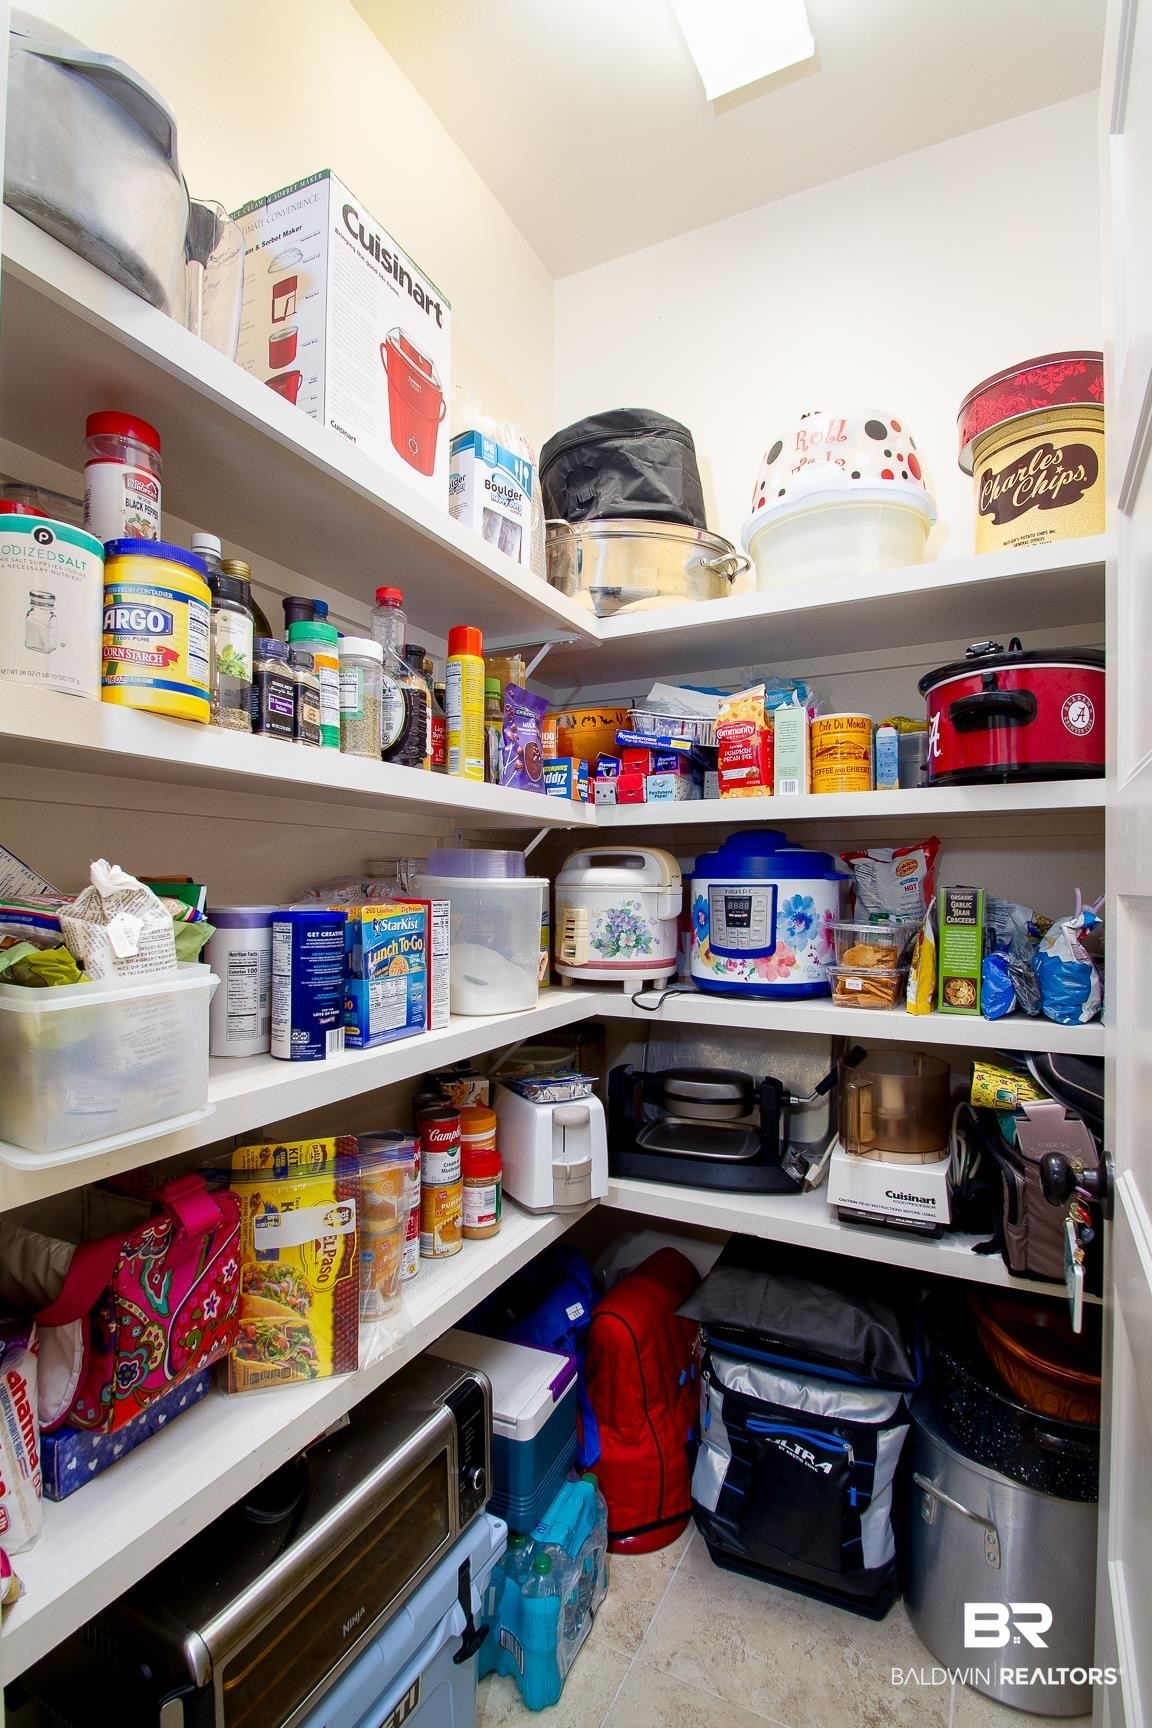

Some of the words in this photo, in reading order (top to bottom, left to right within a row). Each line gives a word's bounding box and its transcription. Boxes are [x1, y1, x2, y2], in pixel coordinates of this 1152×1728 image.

[274, 185, 297, 200] SORBET
[300, 174, 323, 186] MAKER
[242, 220, 266, 234] TIMATE
[266, 193, 320, 224] CONVENIENCE
[262, 235, 281, 248] Sorbet
[283, 225, 302, 237] Maker
[342, 204, 442, 328] Cuisinart
[330, 420, 357, 444] Cuisinart
[484, 480, 522, 501] Boulder
[980, 448, 1063, 512] Charles
[1012, 465, 1086, 506] Chips
[126, 498, 143, 511] BLACK
[1, 545, 56, 560] ODIZED
[58, 554, 86, 571] SALT
[136, 588, 173, 599] CONTAINER
[103, 609, 164, 632] ARGO
[104, 646, 125, 657] CORN
[125, 648, 163, 663] STARCH
[1064, 696, 1093, 713] ALABAMA
[1072, 706, 1086, 722] A
[717, 725, 754, 738] Community
[834, 719, 844, 729] Du
[847, 718, 867, 729] Monde
[814, 767, 833, 776] COFFEE
[904, 884, 917, 892] HOT
[952, 908, 970, 916] NAAN
[381, 918, 419, 932] StarKist
[368, 940, 399, 964] Lunch
[399, 935, 423, 952] To-Go
[289, 1147, 298, 1165] KIT
[871, 1203, 902, 1212] INSTRUCTIONS
[885, 1190, 936, 1205] Cuisinart
[6, 1413, 19, 1442] FAVORITE
[7, 1370, 39, 1472] ahatma
[786, 1449, 804, 1462] ARCTIC
[804, 1461, 819, 1472] ZONE
[343, 1607, 365, 1638] NINJA
